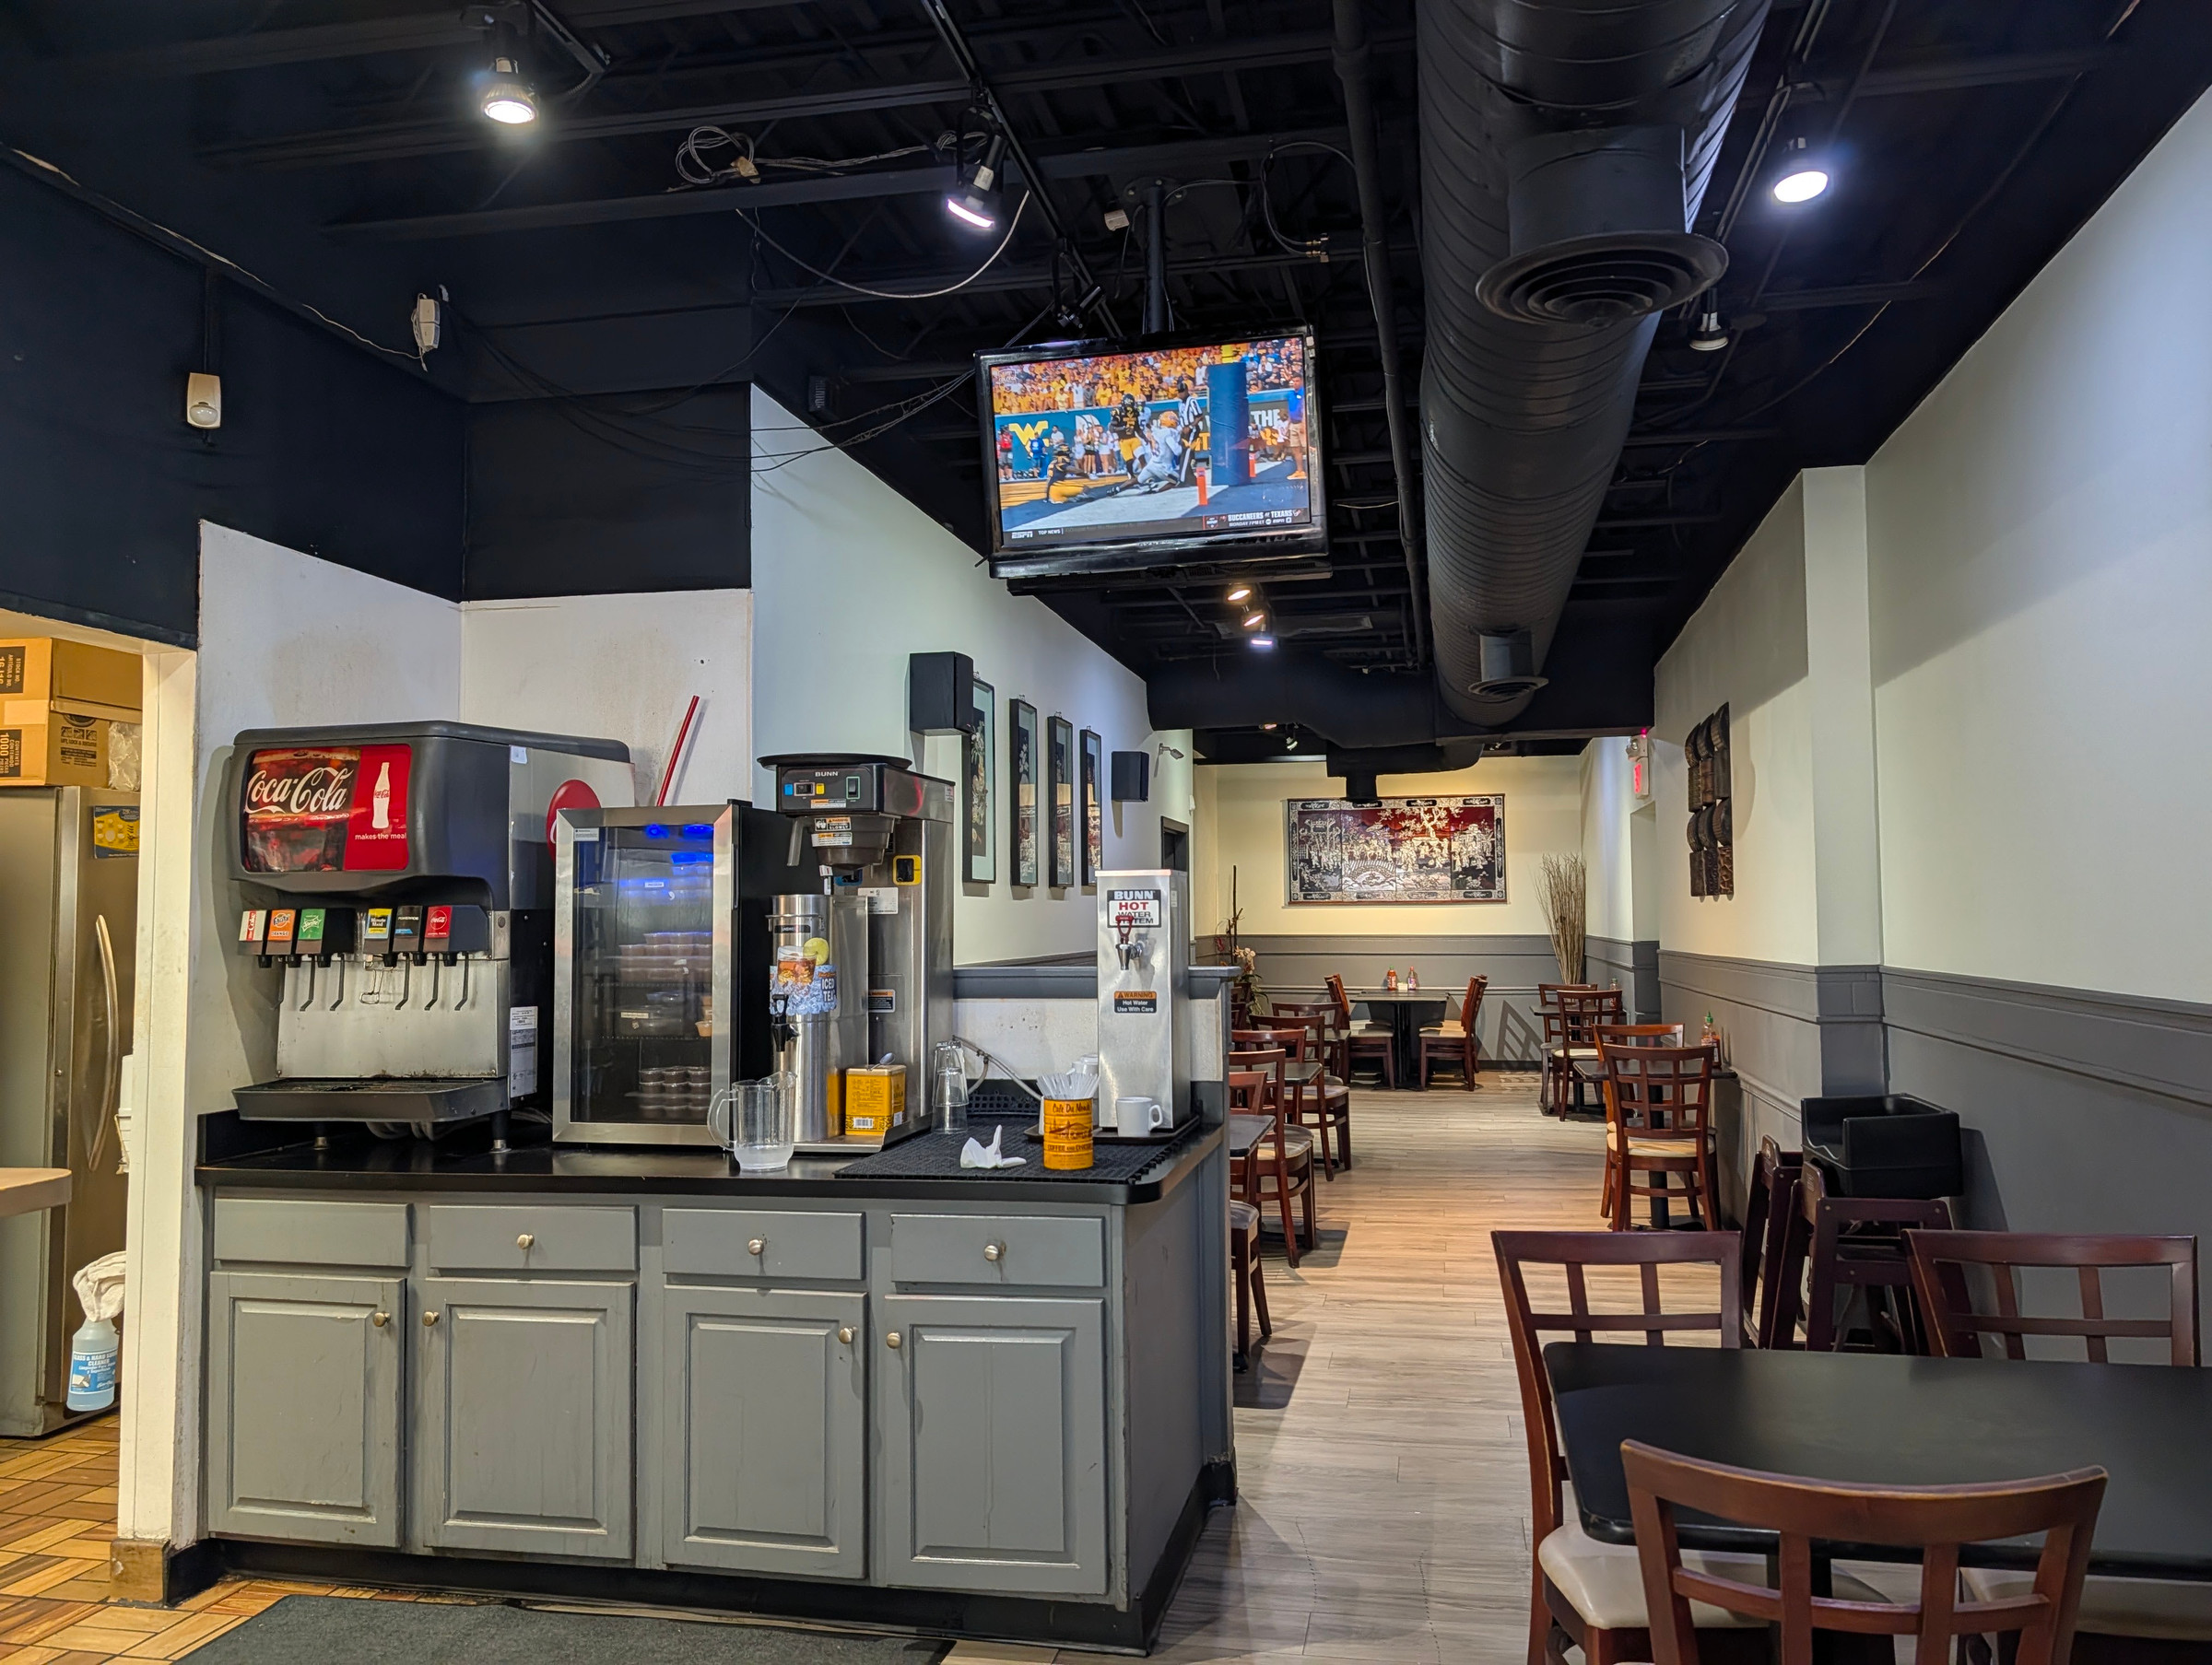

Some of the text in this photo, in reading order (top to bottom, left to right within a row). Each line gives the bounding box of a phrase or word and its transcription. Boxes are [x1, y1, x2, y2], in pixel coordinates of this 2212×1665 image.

[1228, 511, 1264, 522] BUCCANEERS
[1271, 510, 1293, 518] TEXANS
[1011, 531, 1033, 539] ESPN
[0, 733, 9, 756] 1000
[244, 767, 354, 814] Coca-Cola
[1114, 890, 1154, 900] BUNN
[1118, 901, 1149, 910] HOT
[821, 978, 835, 990] ICED
[823, 990, 835, 1003] TEA
